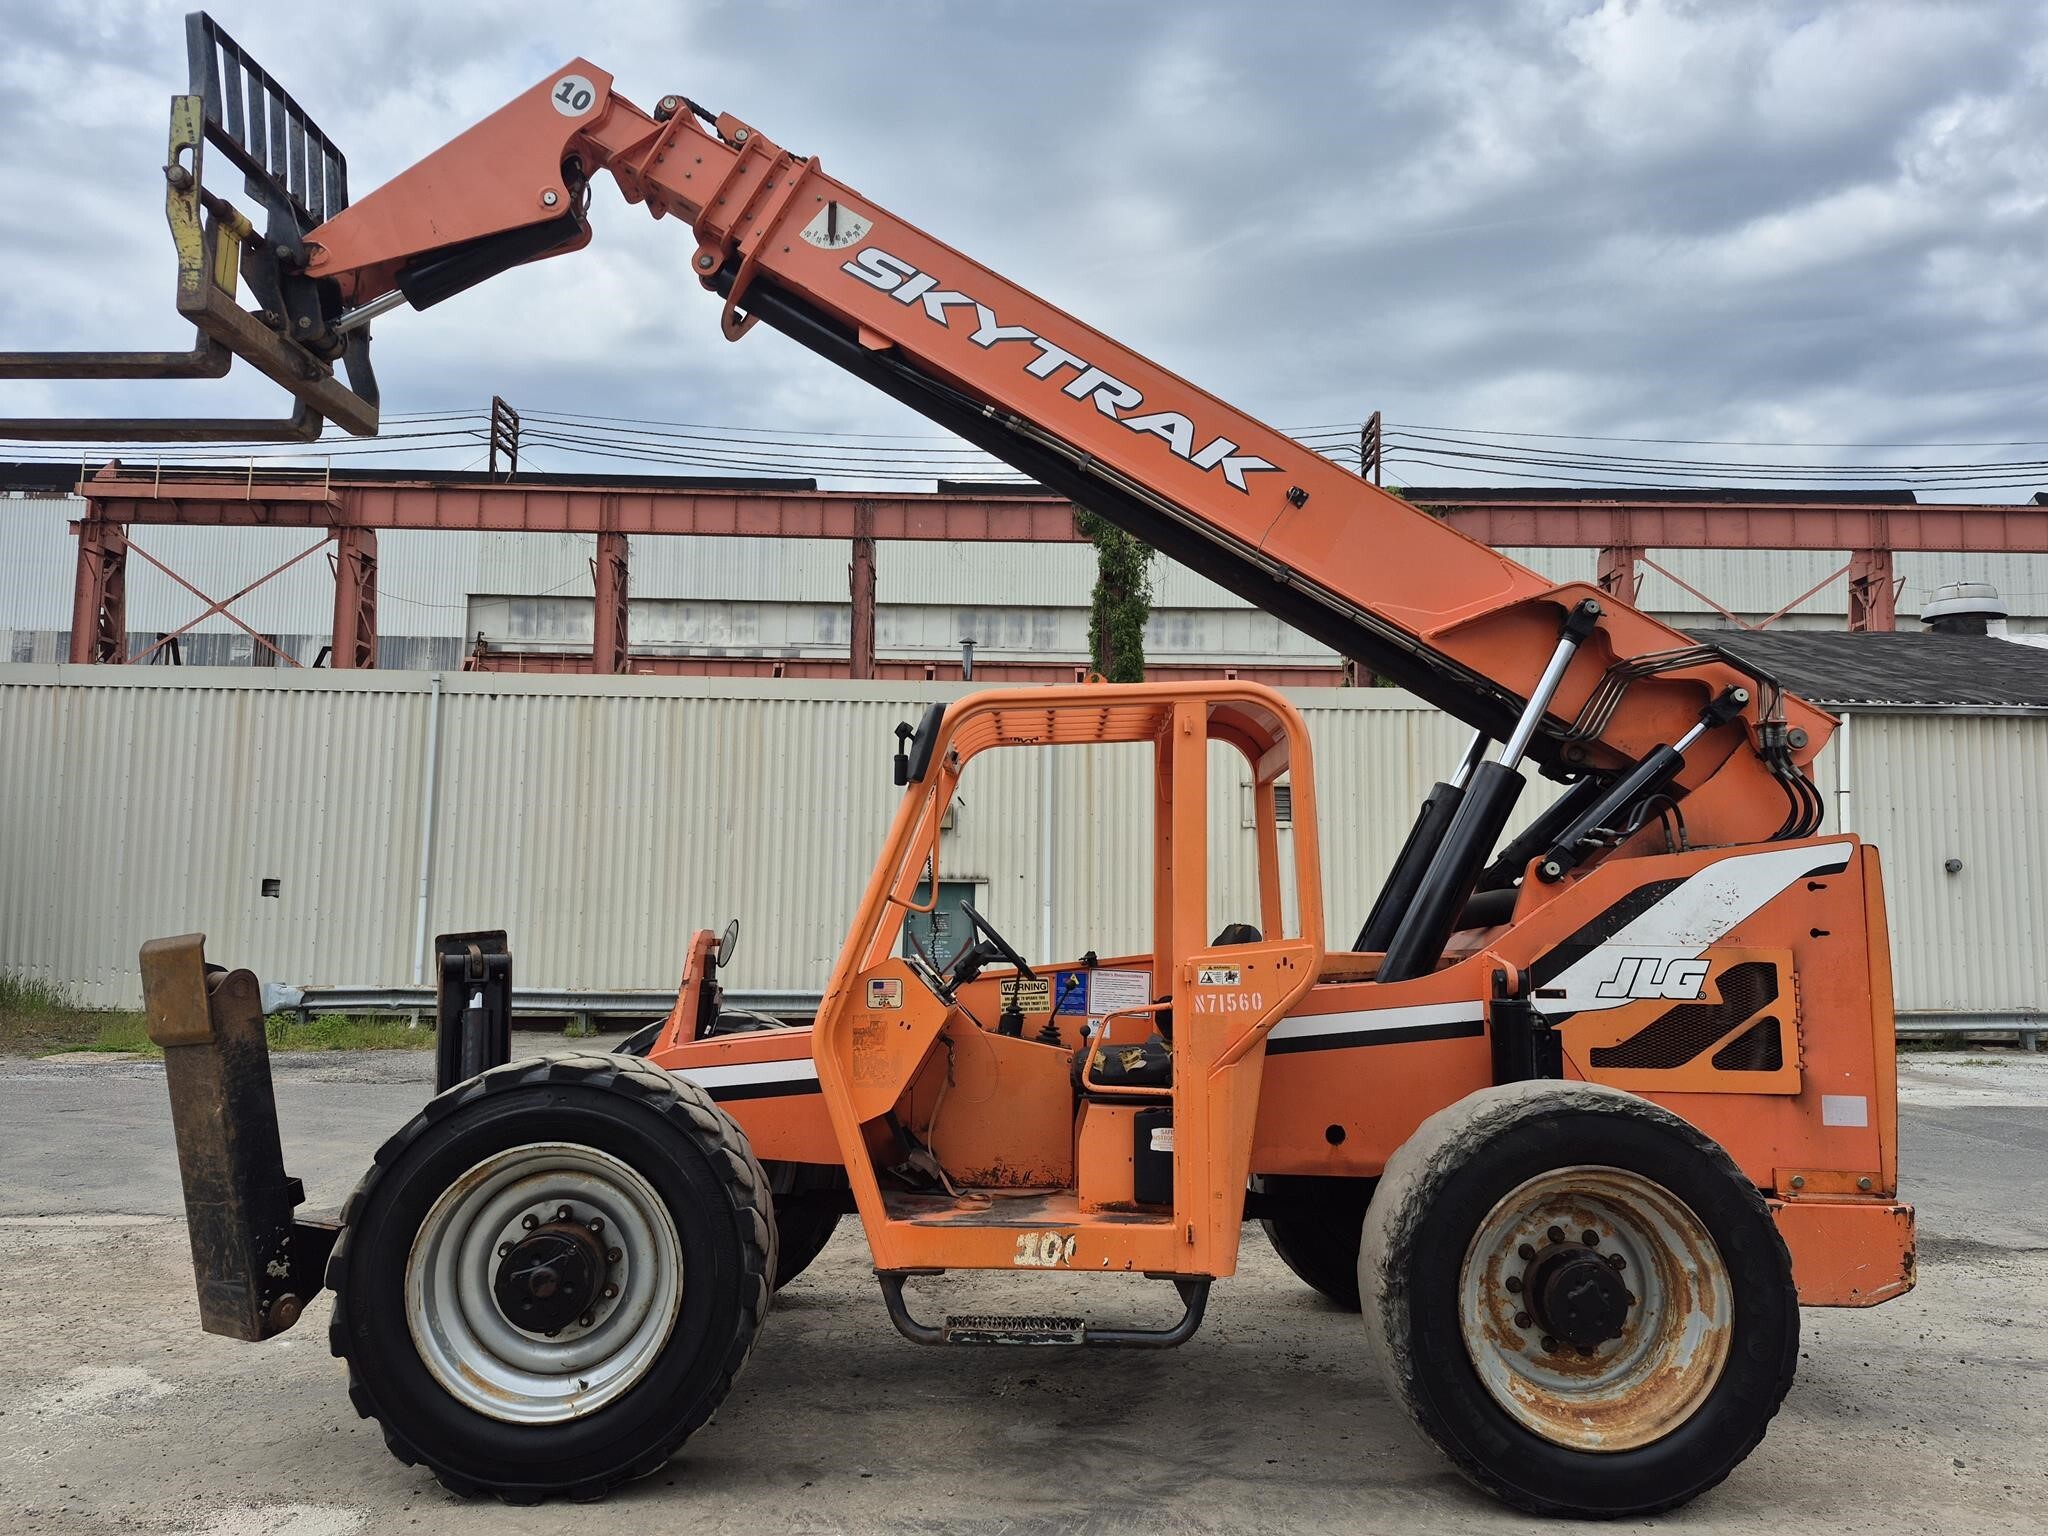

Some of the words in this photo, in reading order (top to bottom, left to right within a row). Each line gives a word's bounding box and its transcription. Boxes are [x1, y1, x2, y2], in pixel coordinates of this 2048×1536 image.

[555, 82, 591, 110] 10
[841, 247, 1286, 494] SKYTRAK
[1003, 982, 1047, 991] WARNING
[1595, 957, 1712, 1000] JLG
[1195, 992, 1262, 1013] N71560
